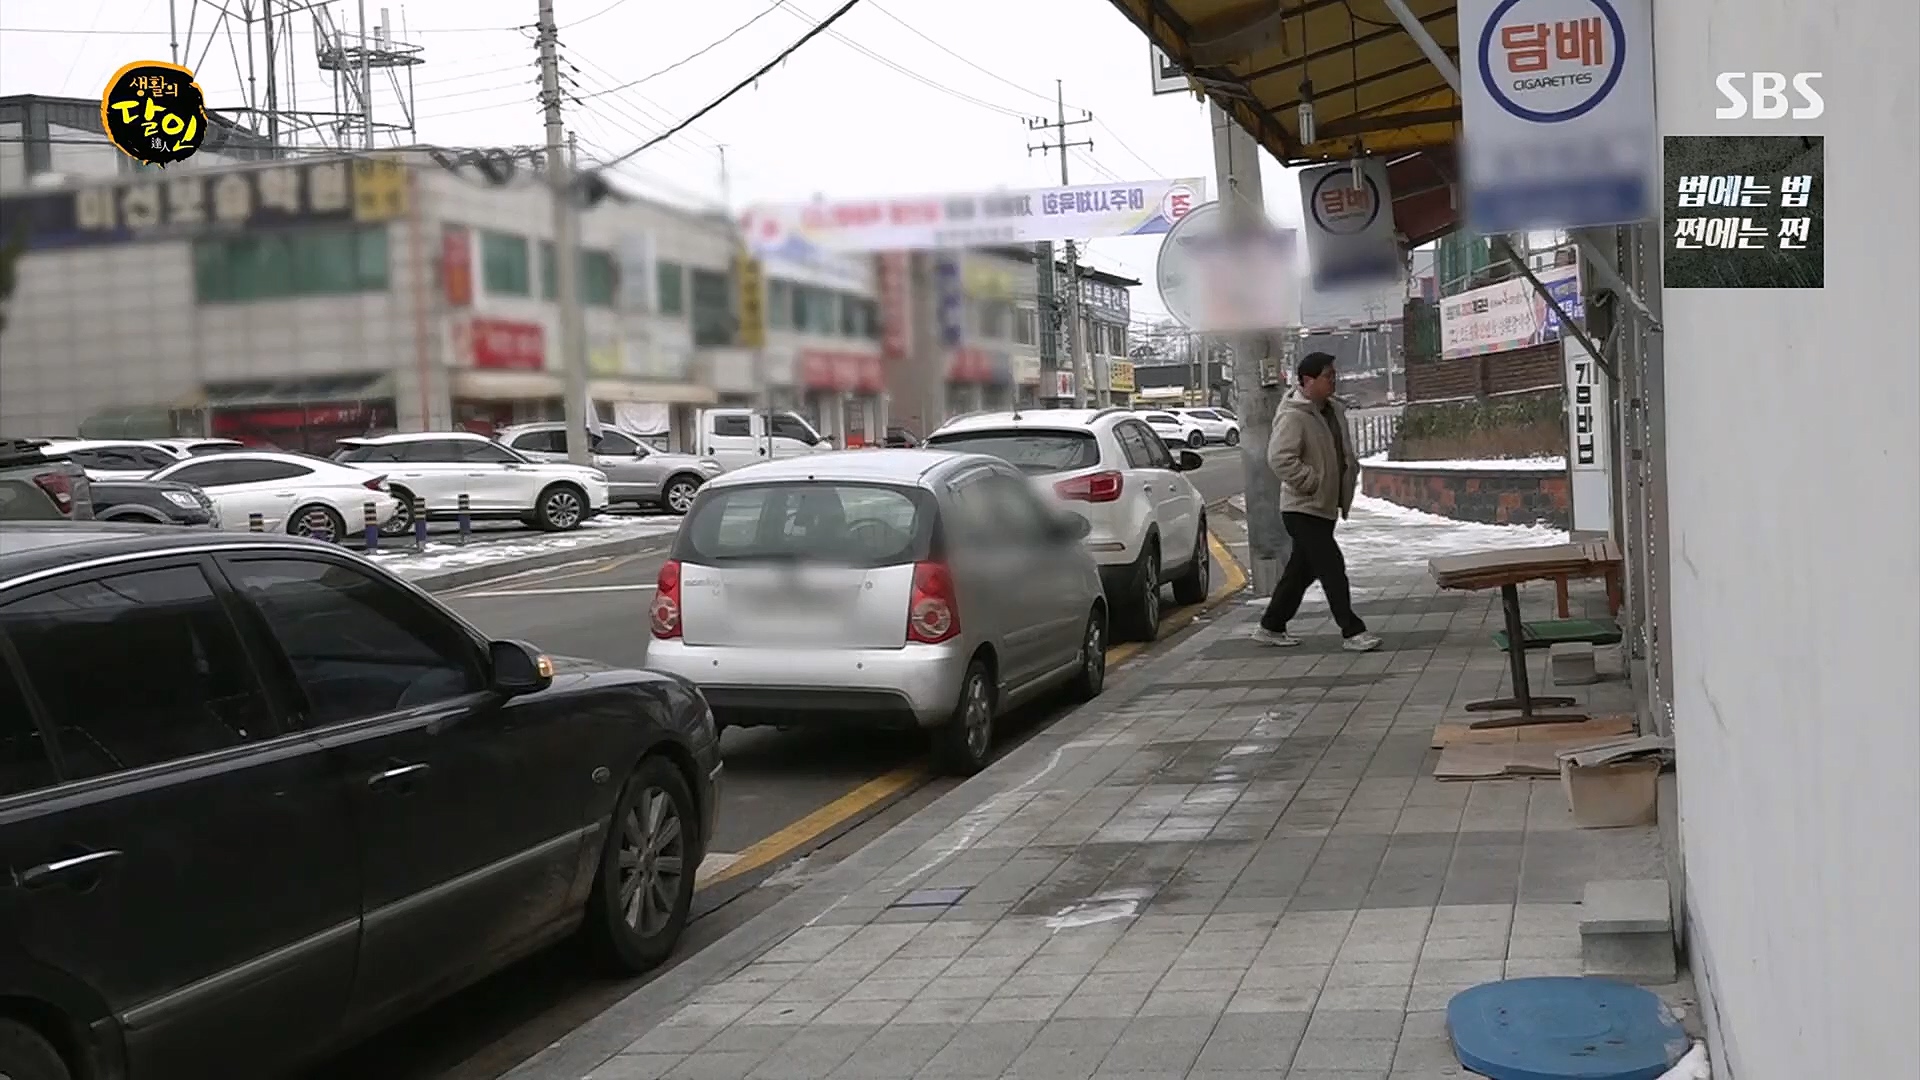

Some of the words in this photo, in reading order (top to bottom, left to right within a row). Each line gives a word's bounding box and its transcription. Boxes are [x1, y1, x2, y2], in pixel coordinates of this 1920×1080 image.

[1501, 17, 1604, 73] 담배
[1513, 72, 1593, 92] CIGARETTES
[1321, 185, 1370, 213] 담배
[1575, 362, 1595, 465] 김밥
